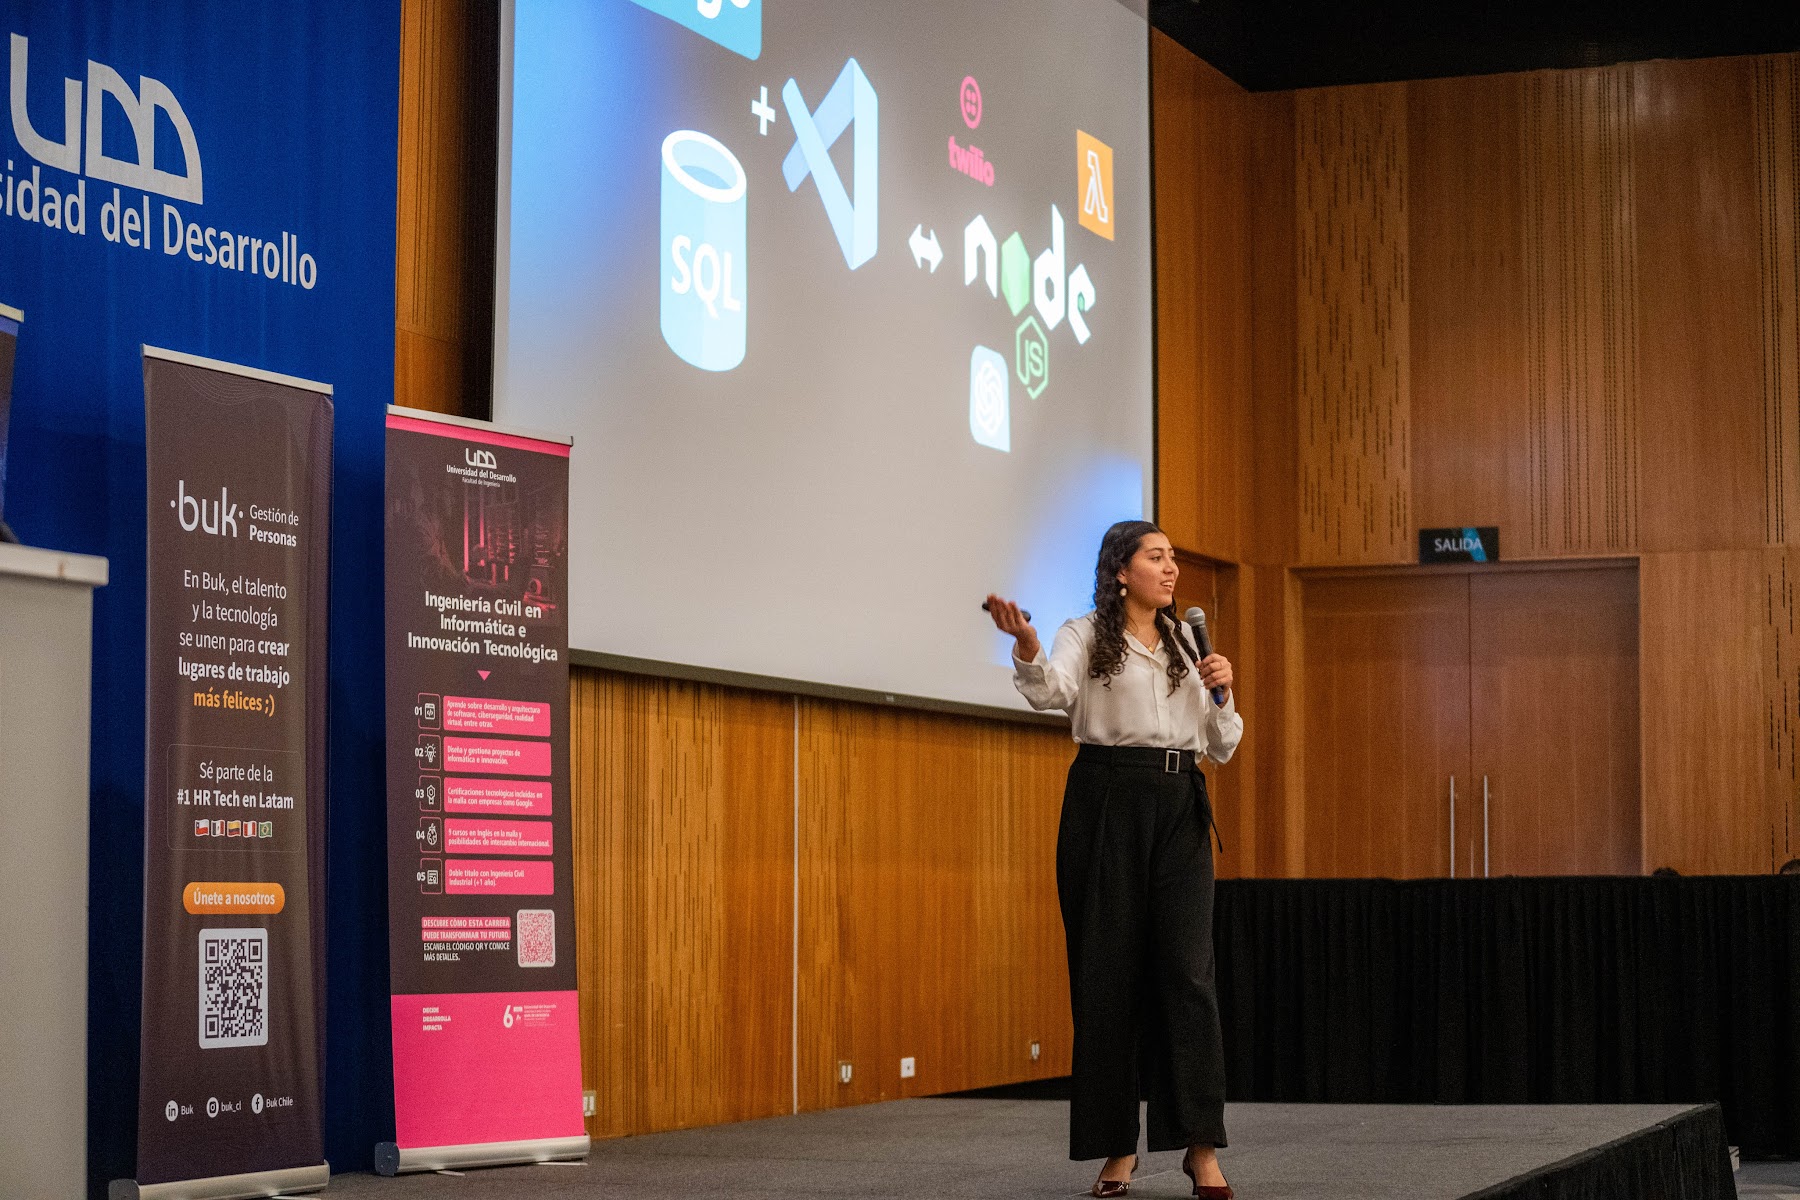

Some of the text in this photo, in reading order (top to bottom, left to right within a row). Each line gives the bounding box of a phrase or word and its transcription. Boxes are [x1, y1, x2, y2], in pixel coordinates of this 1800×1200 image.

[948, 136, 995, 187] twilio
[0, 159, 317, 290] idad del Desarrollo
[671, 234, 742, 319] SQL
[447, 465, 517, 483] Universidad del Desarrollo
[462, 477, 478, 485] Facultad
[250, 505, 287, 524] Gestión
[289, 511, 299, 526] de
[250, 525, 297, 547] Personas
[1435, 538, 1483, 552] SALIDA
[185, 570, 287, 599] En Buk, el talento
[426, 591, 542, 619] Ingeniería Civil en
[192, 600, 278, 630] y la tecnología
[441, 614, 527, 638] Informática e
[180, 632, 290, 656] se unen para crear
[408, 632, 558, 664] Innovación Tecnológica
[179, 657, 290, 689] lugares de trabajo
[194, 687, 275, 717] más felices ;)
[447, 700, 466, 709] Aprende
[468, 702, 482, 710] sobre
[484, 703, 507, 712] desarrollo
[512, 705, 541, 714] arquitectura
[415, 707, 423, 716] 01
[454, 710, 477, 718] software,
[478, 712, 514, 721] ciberseguridad,
[515, 714, 534, 722] realidad
[415, 748, 424, 757] 02
[468, 747, 491, 756] gestiona
[492, 749, 514, 758] proyectos
[200, 760, 273, 784] Sé parte de la
[177, 789, 294, 810] #1 HR Tech en Latam
[416, 789, 424, 798] 03
[448, 788, 484, 796] Certificaciones
[486, 789, 514, 798] tecnológicas
[453, 797, 467, 805] malla
[479, 799, 502, 807] empresas
[516, 799, 533, 808] Google.
[416, 830, 425, 840] 04
[506, 830, 518, 838] malla
[449, 838, 481, 846] posibilidades
[483, 838, 489, 846] de
[490, 839, 517, 847] intercambio
[417, 872, 426, 881] 05
[514, 870, 525, 878] Civil
[474, 879, 483, 887] (+1
[194, 888, 275, 905] Únete a nosotros
[450, 918, 467, 927] CÓMO
[424, 943, 446, 951] ESCANEA
[446, 943, 452, 951] EL
[453, 941, 474, 951] CÓDIGO
[475, 943, 484, 951] QR
[489, 942, 510, 950] CONOCE
[424, 952, 461, 961] MÁS DETALLES.
[503, 1005, 514, 1029] 6
[221, 1101, 242, 1113] buk_cl
[266, 1098, 278, 1108] Buk
[279, 1097, 294, 1107] Chile
[181, 1105, 194, 1115] Buk
